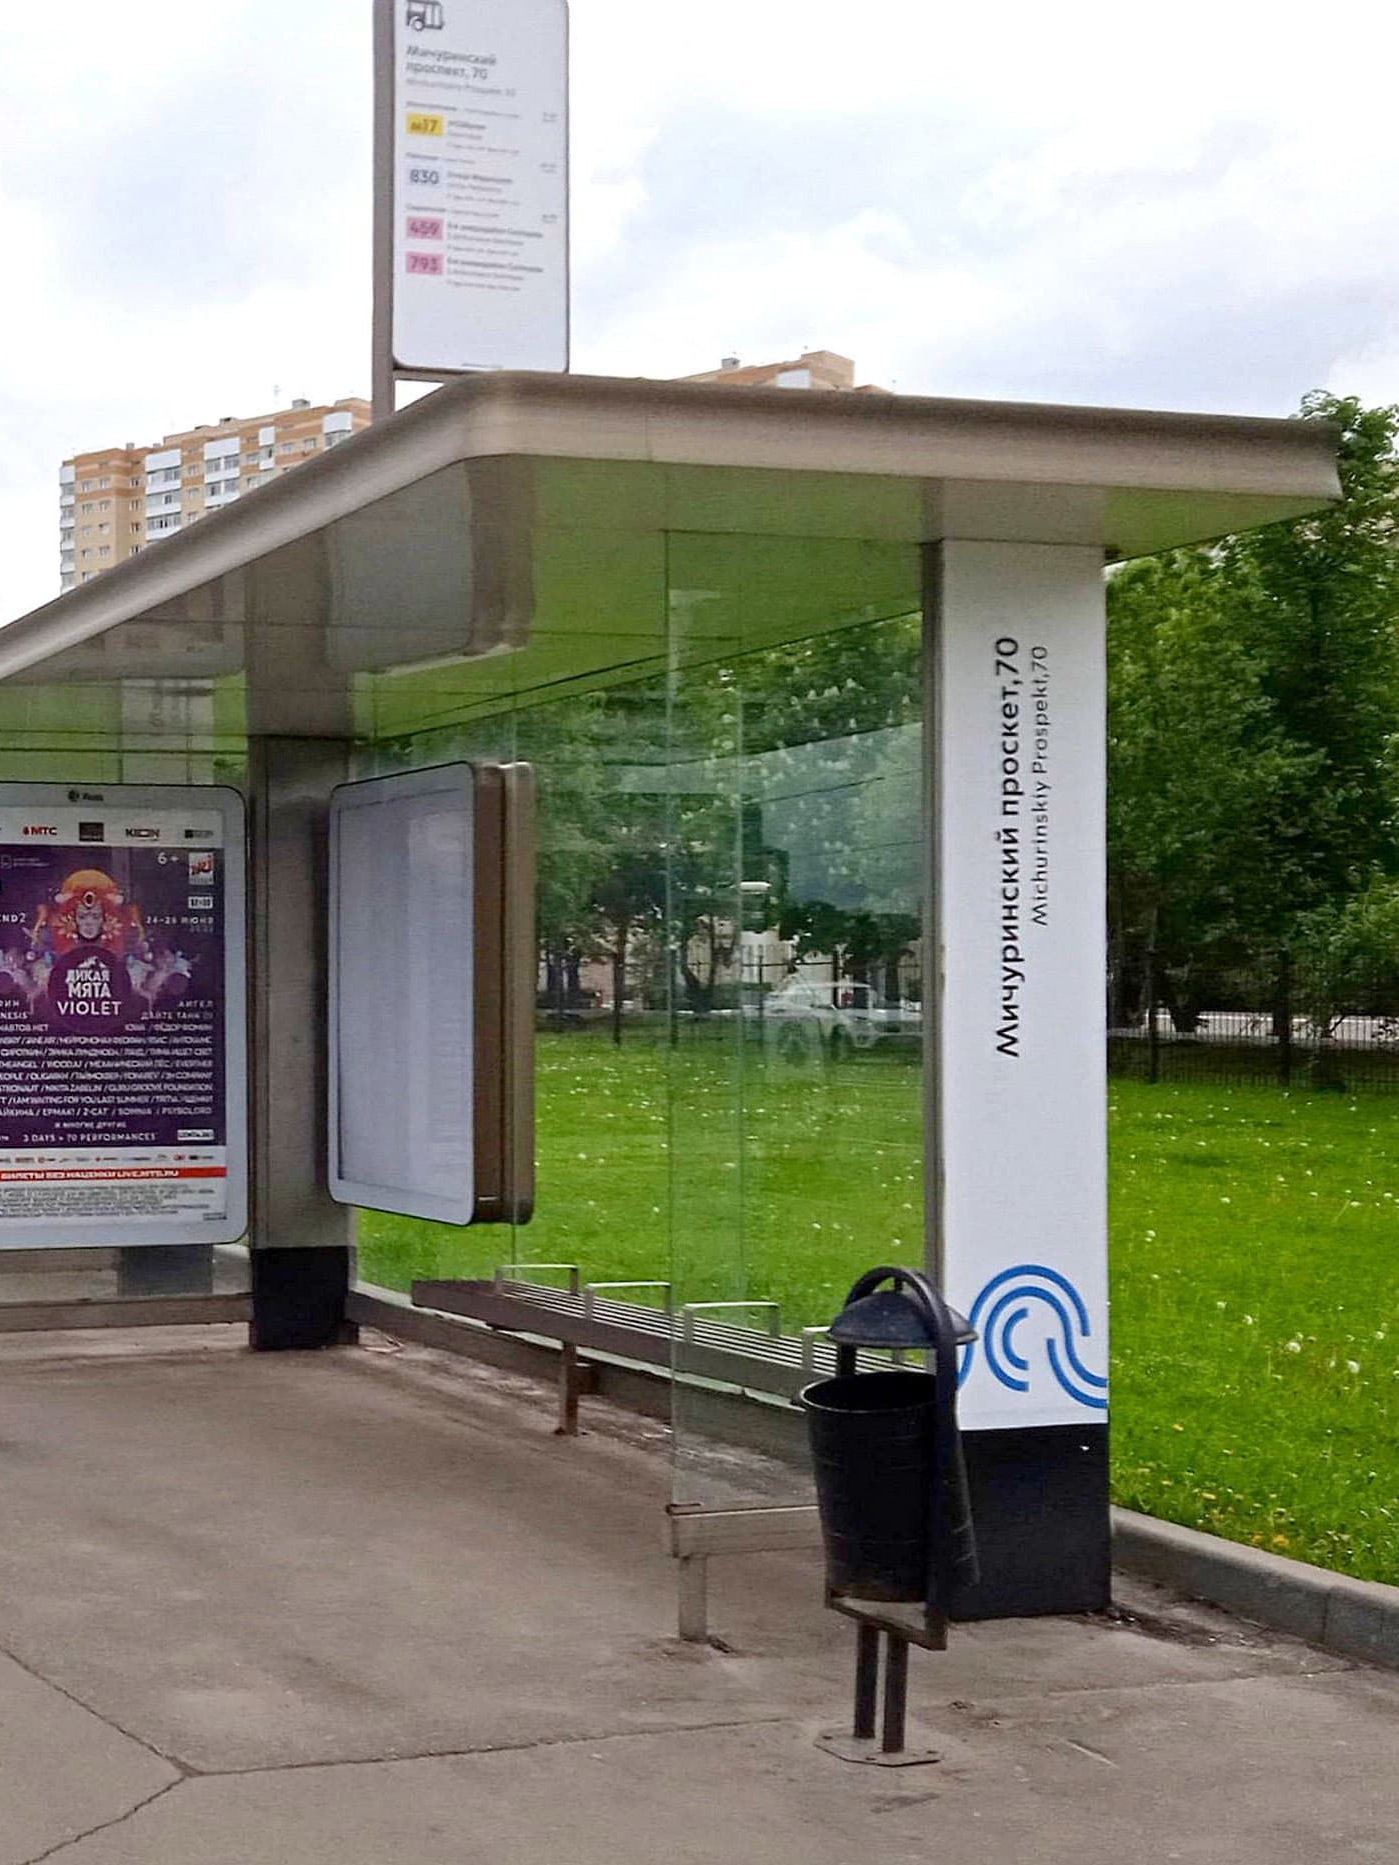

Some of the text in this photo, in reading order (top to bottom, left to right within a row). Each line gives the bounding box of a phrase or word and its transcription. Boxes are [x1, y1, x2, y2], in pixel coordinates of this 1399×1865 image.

[409, 168, 439, 185] 830
[409, 255, 439, 272] 793
[1031, 646, 1052, 926] Michurinskiy Prospekt,70
[995, 637, 1025, 1058] Мичуринский проскет,70
[65, 969, 110, 983] ДИКАЯ
[68, 982, 112, 998] МЯТА
[57, 1001, 122, 1016] VIOLET
